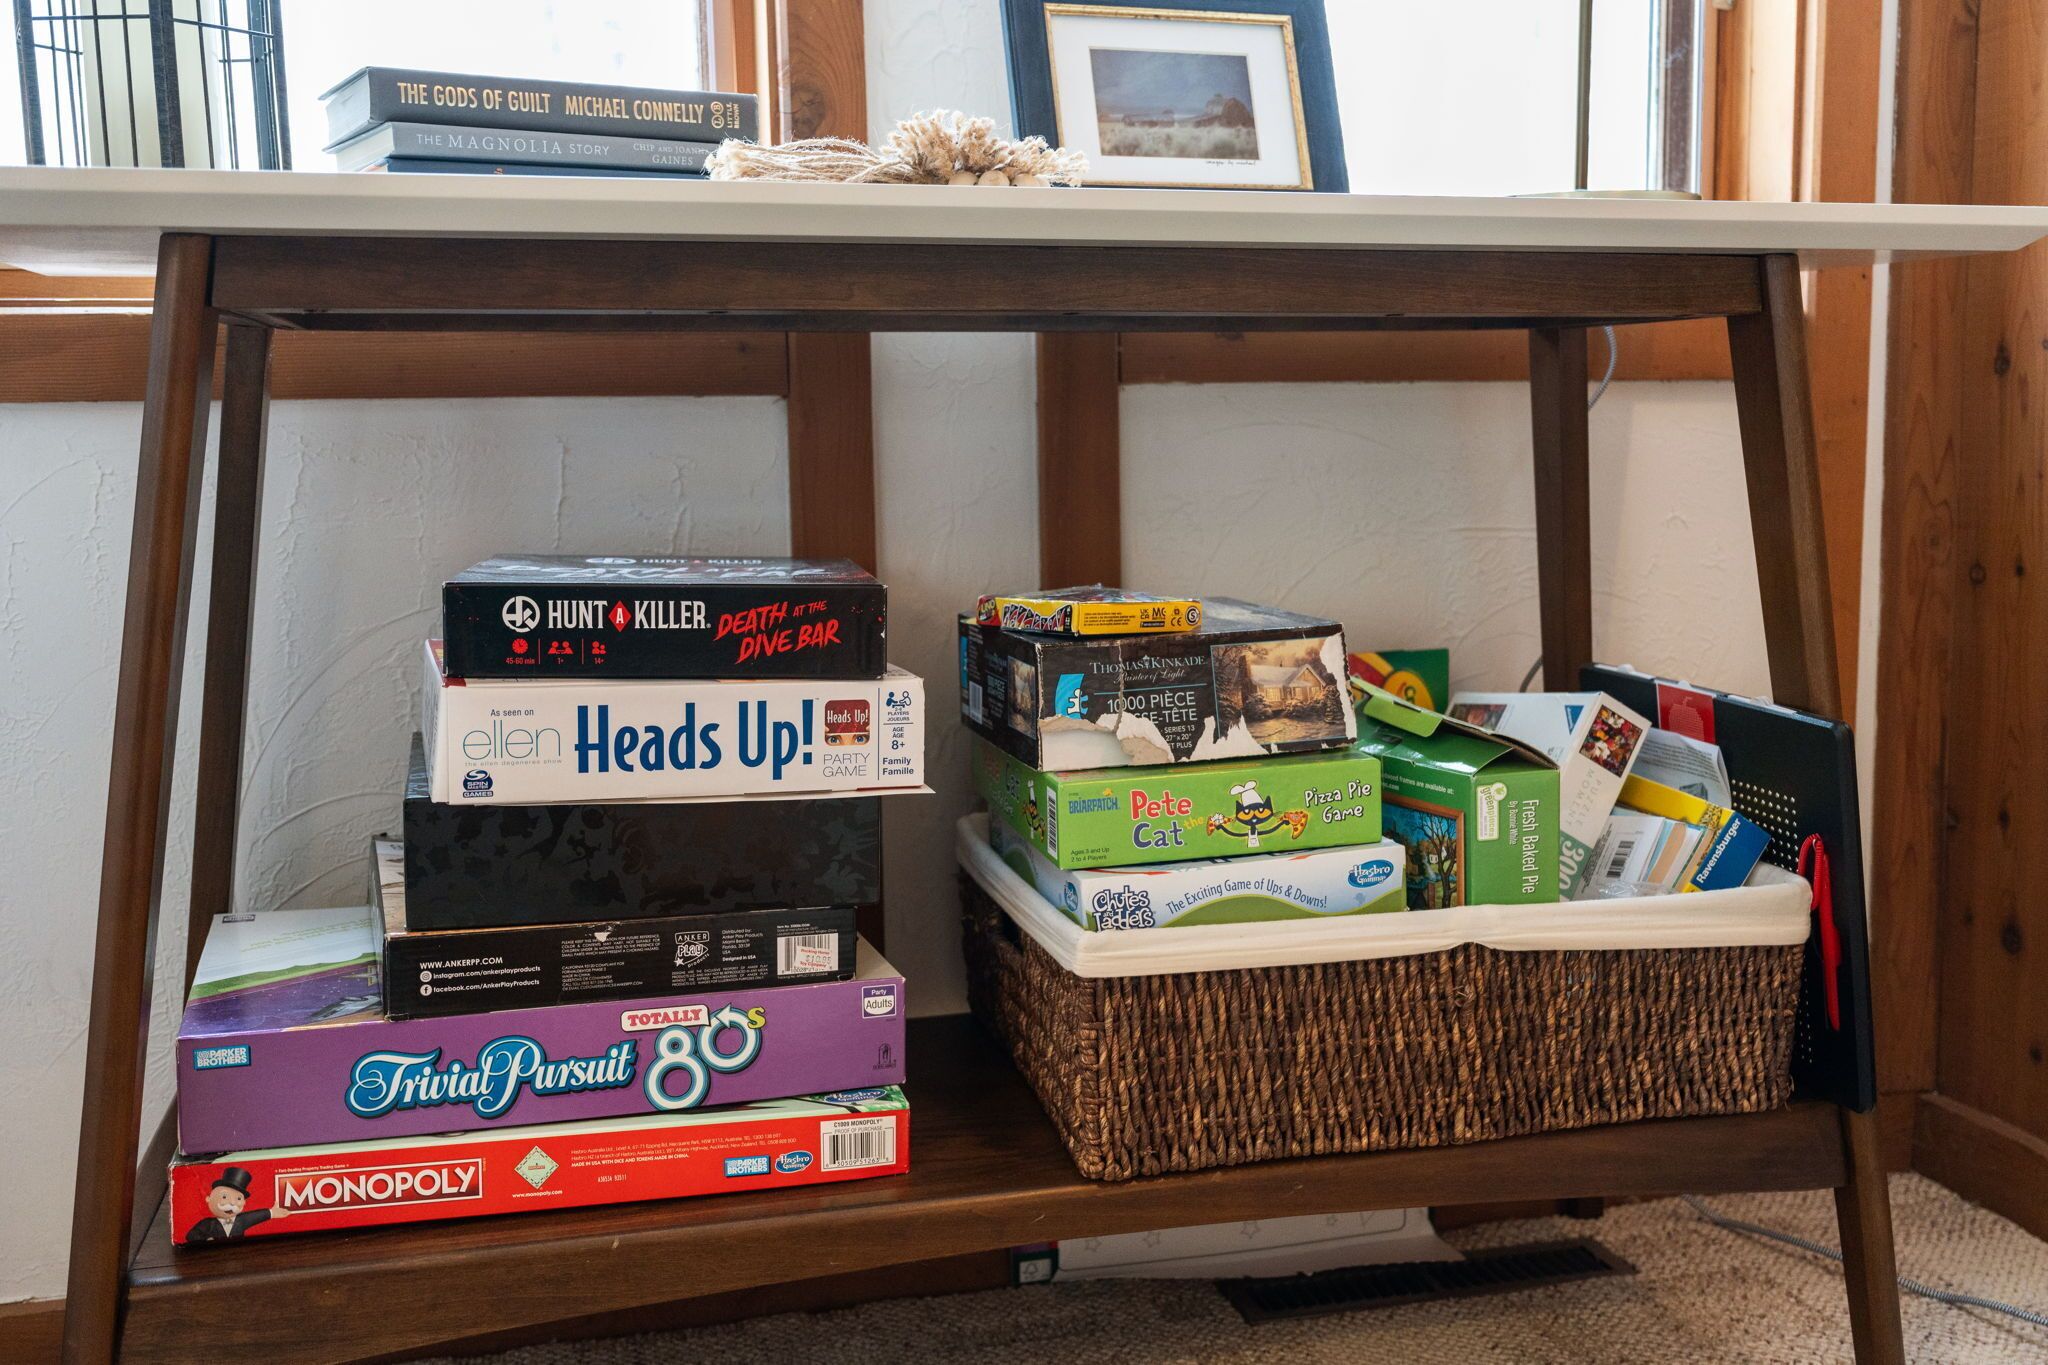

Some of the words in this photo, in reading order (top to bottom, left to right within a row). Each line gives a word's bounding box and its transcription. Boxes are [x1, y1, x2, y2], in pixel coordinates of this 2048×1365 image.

[397, 82, 428, 104] THE
[433, 84, 478, 108] GODS
[483, 88, 502, 110] OF
[508, 91, 550, 113] GUILT
[565, 95, 629, 119] MICHAEL
[633, 100, 704, 124] CONNELLY
[417, 134, 442, 145] THE
[448, 134, 562, 154] MAGNOLIA
[569, 144, 610, 156] STORY
[633, 143, 655, 152] CHIP
[658, 145, 672, 153] AND
[652, 154, 693, 166] GAINES
[981, 599, 996, 612] UNO
[548, 600, 608, 629] HUNT
[616, 607, 625, 624] A
[634, 600, 706, 629] KILLER
[713, 601, 788, 641] DEATH
[793, 606, 805, 617] AT
[807, 600, 828, 613] THE
[1171, 617, 1182, 626] CE
[735, 630, 793, 665] DIVE
[793, 619, 842, 652] BAR
[1090, 661, 1144, 674] THOMAS
[1151, 656, 1206, 668] KINKADE
[1114, 674, 1148, 683] Painter
[1150, 673, 1157, 682] of
[1159, 669, 1183, 680] Light
[1151, 690, 1195, 708] PIÈCE
[827, 710, 851, 723] Heads
[855, 709, 868, 725] Up!
[1164, 726, 1186, 734] SERIES
[463, 720, 560, 760] ellen
[575, 703, 721, 773] Heads
[739, 699, 813, 780] Up!
[892, 740, 905, 750] 8+
[1177, 741, 1193, 749] PLUS
[823, 753, 870, 765] PARTY
[883, 757, 911, 765] Family
[823, 765, 867, 777] GAME
[883, 767, 914, 775] Famille
[1400, 775, 1415, 786] frames
[1304, 788, 1342, 808] Pizza
[1348, 780, 1372, 799] Pie
[1567, 769, 1594, 826] MOMENT
[1069, 797, 1119, 814] BRIARPATCH
[1130, 789, 1192, 820] Pete
[1575, 781, 1602, 827] PUZZLE
[1322, 805, 1363, 824] Game
[1510, 809, 1518, 828] Bonnie
[1522, 800, 1539, 831] Fresh
[1184, 816, 1204, 830] the
[1133, 821, 1184, 849] Cat
[1510, 828, 1518, 845] White
[1088, 854, 1107, 862] Players
[1522, 835, 1539, 872] Baked
[1696, 818, 1741, 883] Ravensburger
[1352, 864, 1391, 878] Hasbro
[1356, 874, 1386, 884] Gaming
[1522, 876, 1539, 893] Pie
[1092, 885, 1150, 912] Chutes
[1166, 897, 1185, 915] The
[1184, 883, 1223, 906] Exciting
[1224, 879, 1251, 892] Game
[1254, 878, 1265, 891] of
[1266, 879, 1283, 895] Ups
[1284, 885, 1292, 897] &
[1293, 887, 1327, 908] Downs!
[1093, 908, 1155, 932] Ladders
[678, 933, 707, 941] ANKER
[420, 957, 503, 969] WWW.ANKERPP.COM
[688, 953, 710, 968] products
[434, 980, 540, 993] facebook.com/AnkerPlayProducts
[866, 998, 893, 1009] Adults
[628, 1008, 703, 1027] TOTALLY
[209, 1047, 246, 1058] PARKER
[197, 1056, 247, 1067] BROTHERS
[349, 1049, 497, 1114] Trivial
[477, 1038, 634, 1114] Pursuit
[831, 1090, 881, 1099] Hasbro
[737, 1157, 768, 1166] PARKER
[778, 1153, 810, 1165] Hasbro
[727, 1164, 768, 1174] BROTHERS
[284, 1165, 476, 1208] MONOPOLY
[512, 1190, 562, 1198] www.monopoly.com
